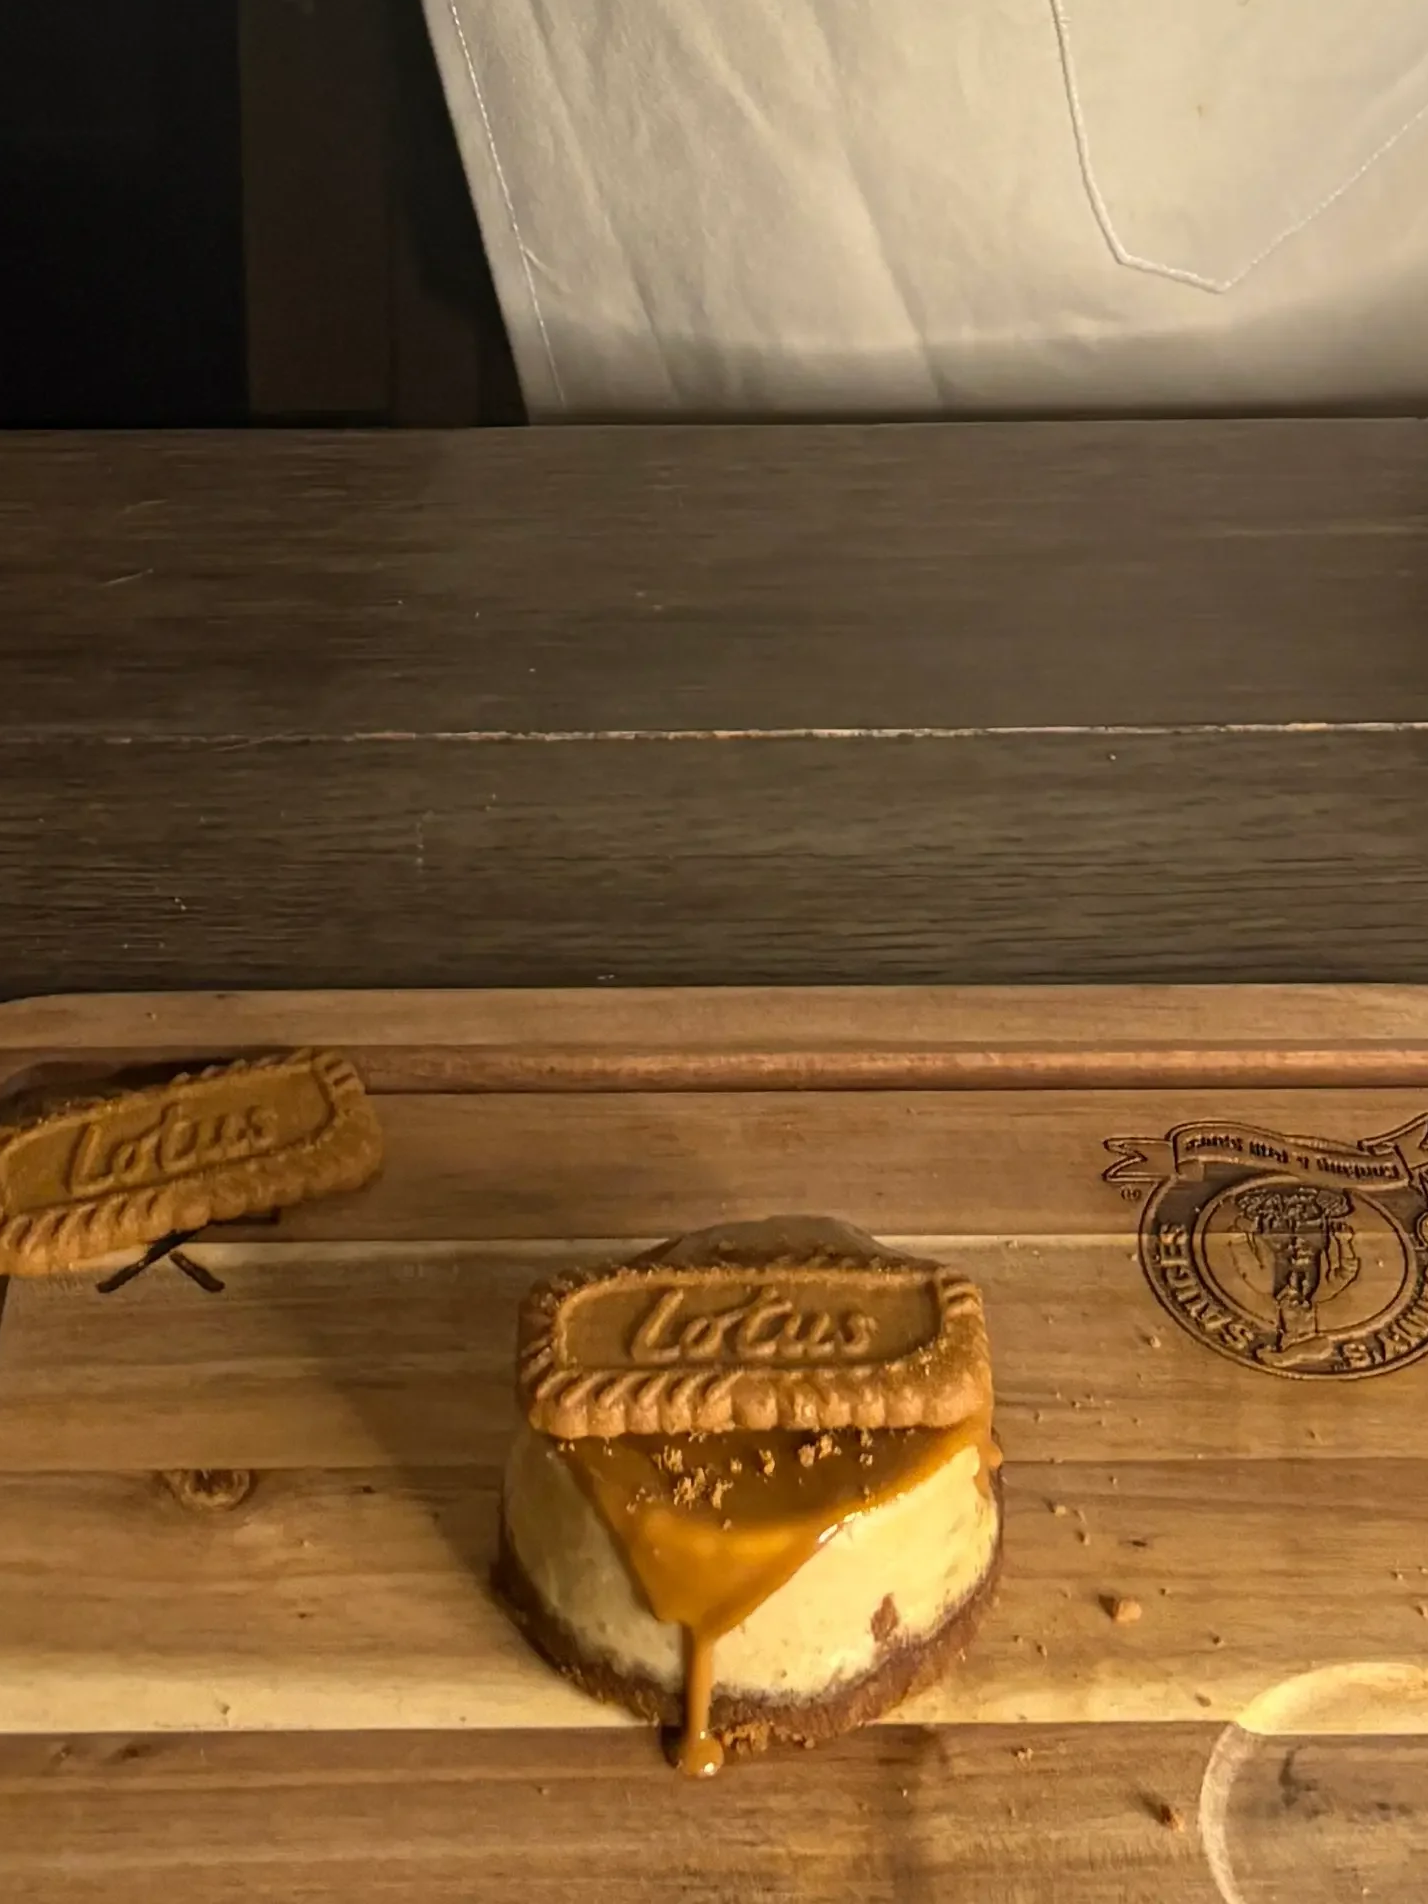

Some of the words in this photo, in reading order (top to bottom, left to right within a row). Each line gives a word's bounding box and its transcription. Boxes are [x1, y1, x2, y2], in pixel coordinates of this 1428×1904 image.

[67, 1103, 277, 1194] Lotus
[628, 1285, 875, 1363] Lotus
[1159, 1222, 1255, 1350] SAUCES
